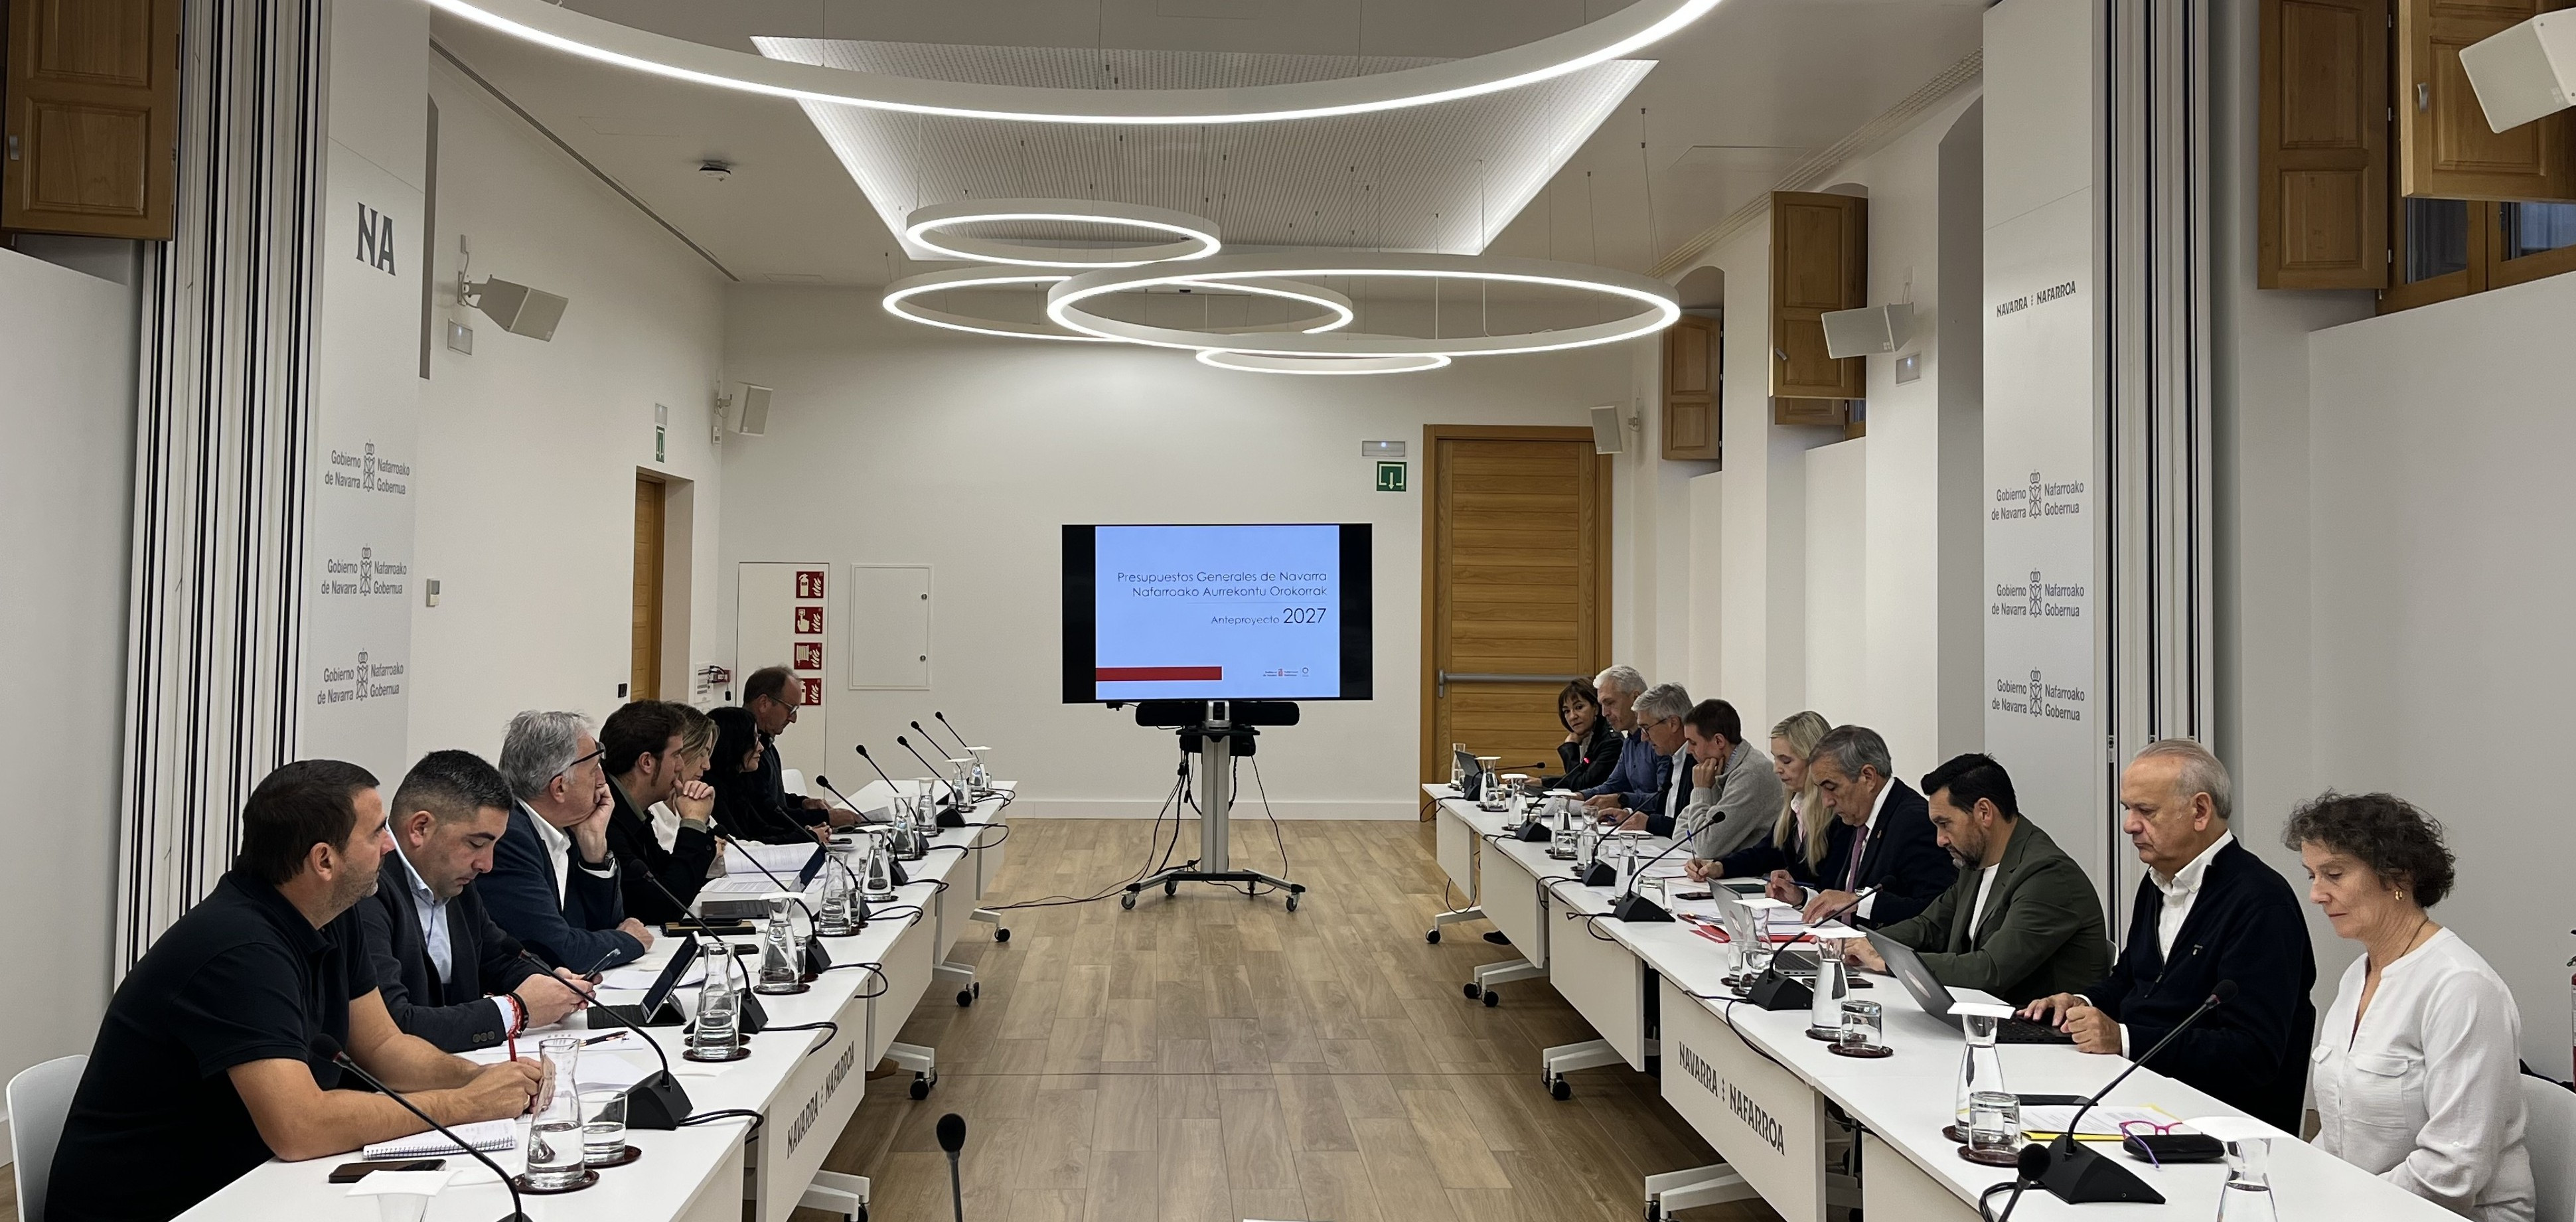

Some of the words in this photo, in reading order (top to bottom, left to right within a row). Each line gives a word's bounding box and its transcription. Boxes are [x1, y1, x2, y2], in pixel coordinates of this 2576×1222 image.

[356, 202, 396, 276] NA
[1997, 296, 2028, 317] NAVARRA
[2036, 280, 2076, 305] NAFARROA
[331, 449, 361, 469] Gobierno
[377, 457, 410, 477] Nafarroako
[324, 470, 334, 486] de
[335, 471, 360, 489] Navarra
[376, 477, 406, 495] Gobernua
[1996, 488, 2026, 502] Gobierno
[2044, 480, 2084, 496] Nafarroako
[1991, 508, 2000, 521] de
[2001, 507, 2026, 520] Navarra
[2044, 502, 2080, 516] Gobernua
[327, 558, 358, 574] Gobierno
[374, 560, 408, 575] Nafarroako
[1118, 572, 1193, 584] Presupuestos
[1196, 571, 1257, 582] Generales
[1260, 572, 1276, 581] de
[1280, 572, 1327, 581] Navarra
[321, 579, 330, 595] de
[331, 580, 357, 595] Navarra
[373, 580, 403, 595] Gobernua
[1132, 586, 1199, 597] Nafarroako
[1202, 586, 1266, 597] Aurrekontu
[1270, 585, 1327, 596] Orokorrak
[1997, 583, 2027, 597] Gobierno
[2044, 583, 2085, 597] Nafarroako
[1211, 615, 1280, 626] Anteproyecto
[1282, 607, 1327, 624] 2027
[1991, 602, 2000, 615] de
[2001, 602, 2027, 616] Navarra
[2044, 603, 2080, 617] Gobernua
[323, 667, 354, 683] Gobierno
[370, 661, 404, 678] Nafarroako
[370, 683, 400, 698] Gobernua
[1997, 678, 2027, 695] Gobierno
[2045, 684, 2085, 702] Nafarroako
[317, 690, 326, 705] de
[327, 688, 354, 704] Navarra
[1991, 697, 2001, 710] de
[2001, 698, 2027, 714] Navarra
[2044, 706, 2080, 722] Gobernua
[787, 1091, 818, 1160] NAVARRA
[824, 1039, 855, 1104] NAFARROA
[1679, 1041, 1718, 1098] NAVARRA
[1729, 1083, 1785, 1156] NAFARROA
